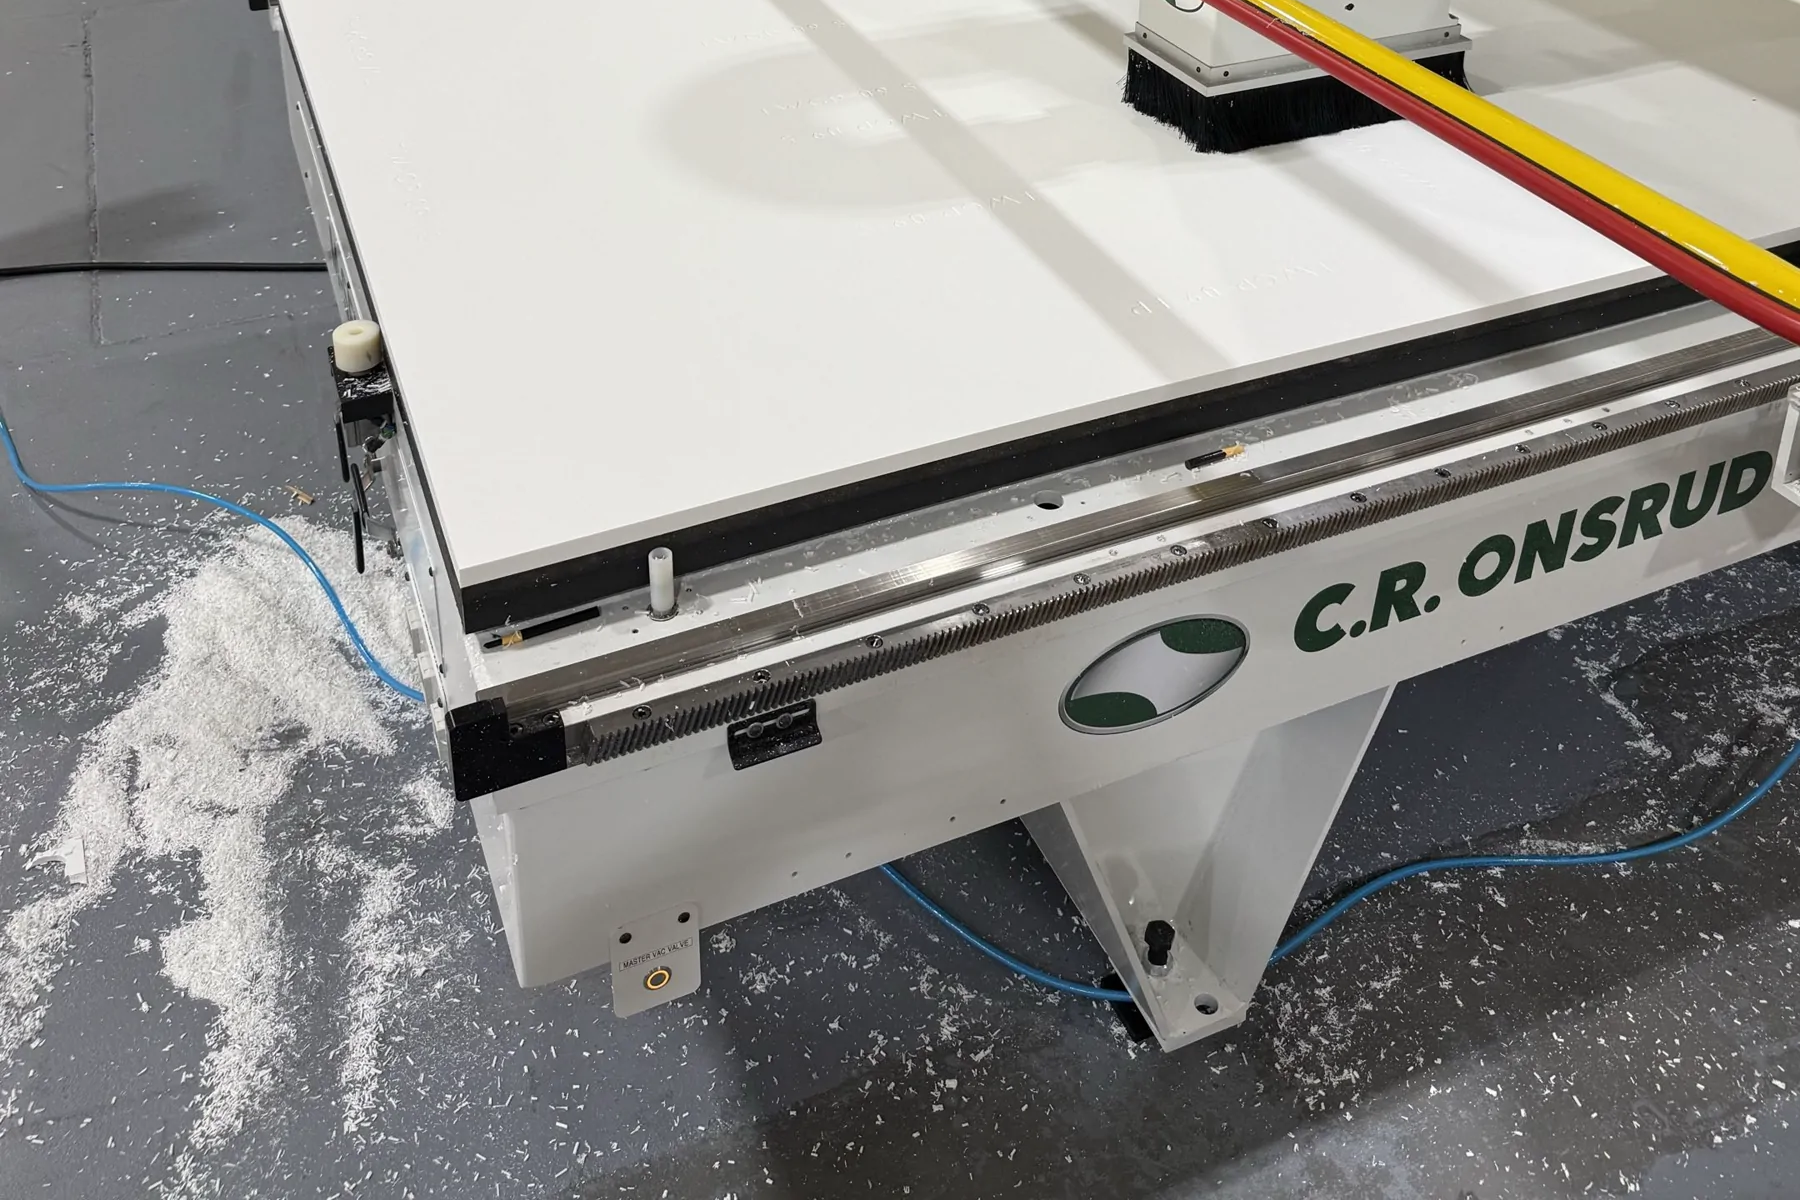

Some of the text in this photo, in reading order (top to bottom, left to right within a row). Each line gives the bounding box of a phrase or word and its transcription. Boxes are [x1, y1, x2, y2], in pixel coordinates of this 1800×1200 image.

[1294, 450, 1774, 652] C.R. ONSRUD
[623, 940, 689, 968] MASTER VAC VALVE
